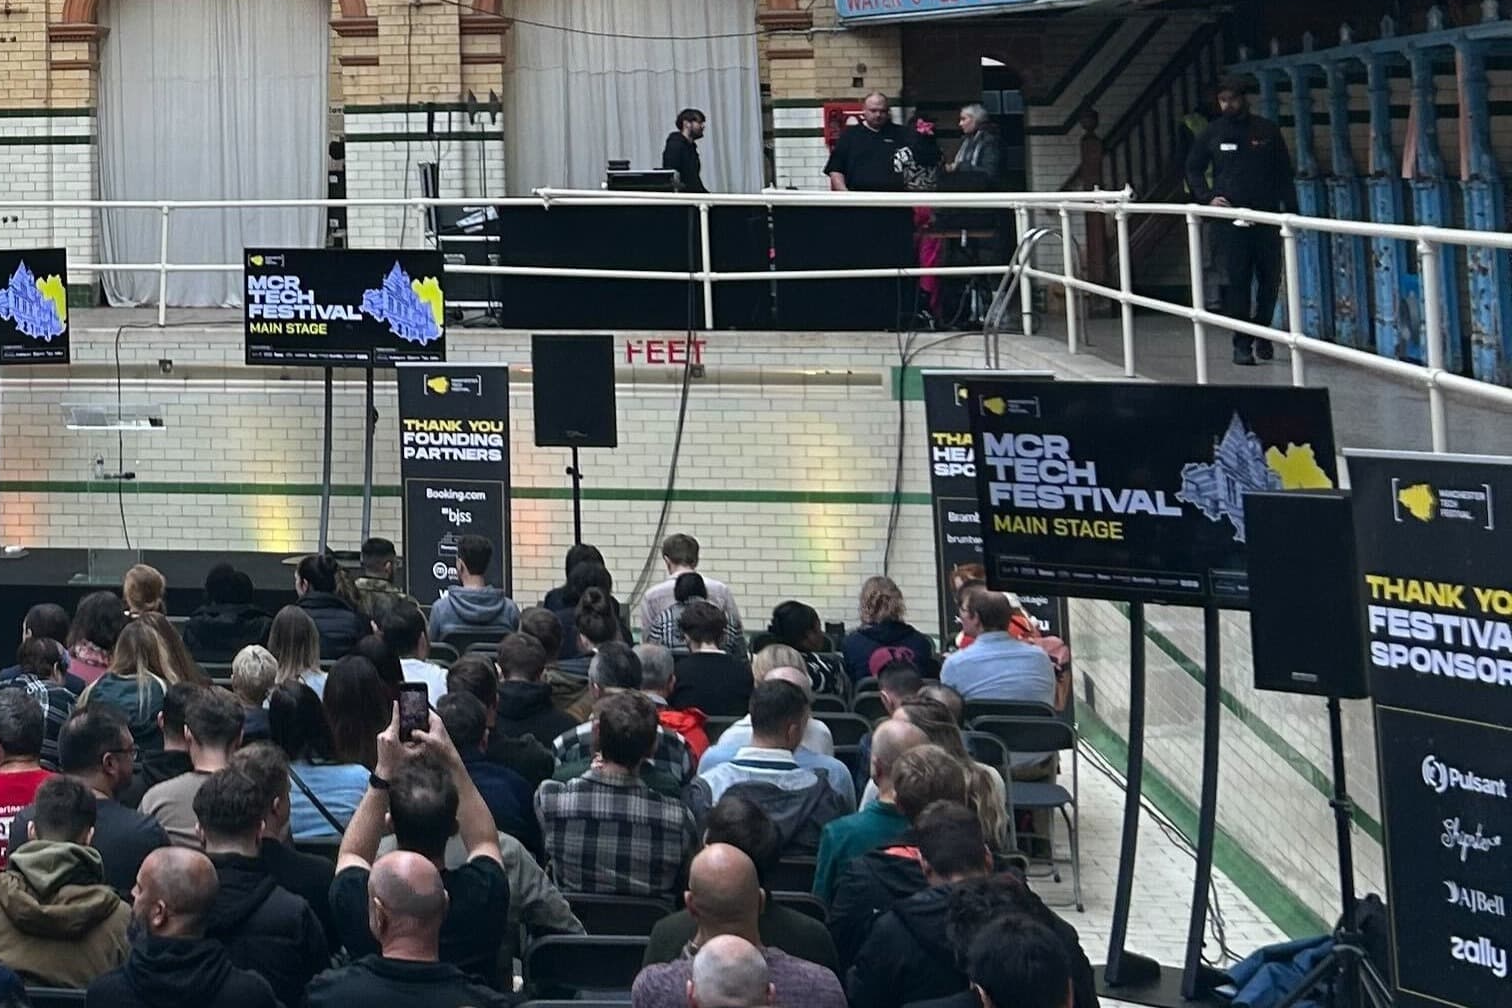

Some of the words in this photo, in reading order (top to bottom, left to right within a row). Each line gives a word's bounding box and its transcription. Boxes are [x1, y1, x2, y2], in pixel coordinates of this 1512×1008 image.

[248, 275, 300, 290] MCR
[248, 289, 314, 304] TECH
[249, 304, 363, 320] FESTIVAL
[250, 322, 283, 334] MAIN
[287, 323, 328, 335] STAGE
[625, 340, 707, 364] FEET
[403, 419, 462, 432] THANK
[468, 420, 503, 432] YOU
[403, 432, 503, 447] FOUNDING
[932, 432, 973, 446] THA
[982, 432, 1070, 460] MCR
[404, 446, 502, 461] PARTNERS
[986, 457, 1097, 486] TECH
[426, 487, 486, 502] Booking.com
[989, 482, 1183, 517] FESTIVAL
[993, 514, 1048, 535] MAIN
[1053, 518, 1125, 540] STAGE
[1365, 574, 1467, 610] THANK
[1473, 586, 1512, 616] YO
[1367, 604, 1512, 653] FESTIVA
[1370, 640, 1512, 686] SPONSOR
[1449, 767, 1508, 798] Pulsant
[1450, 936, 1508, 978] zally
